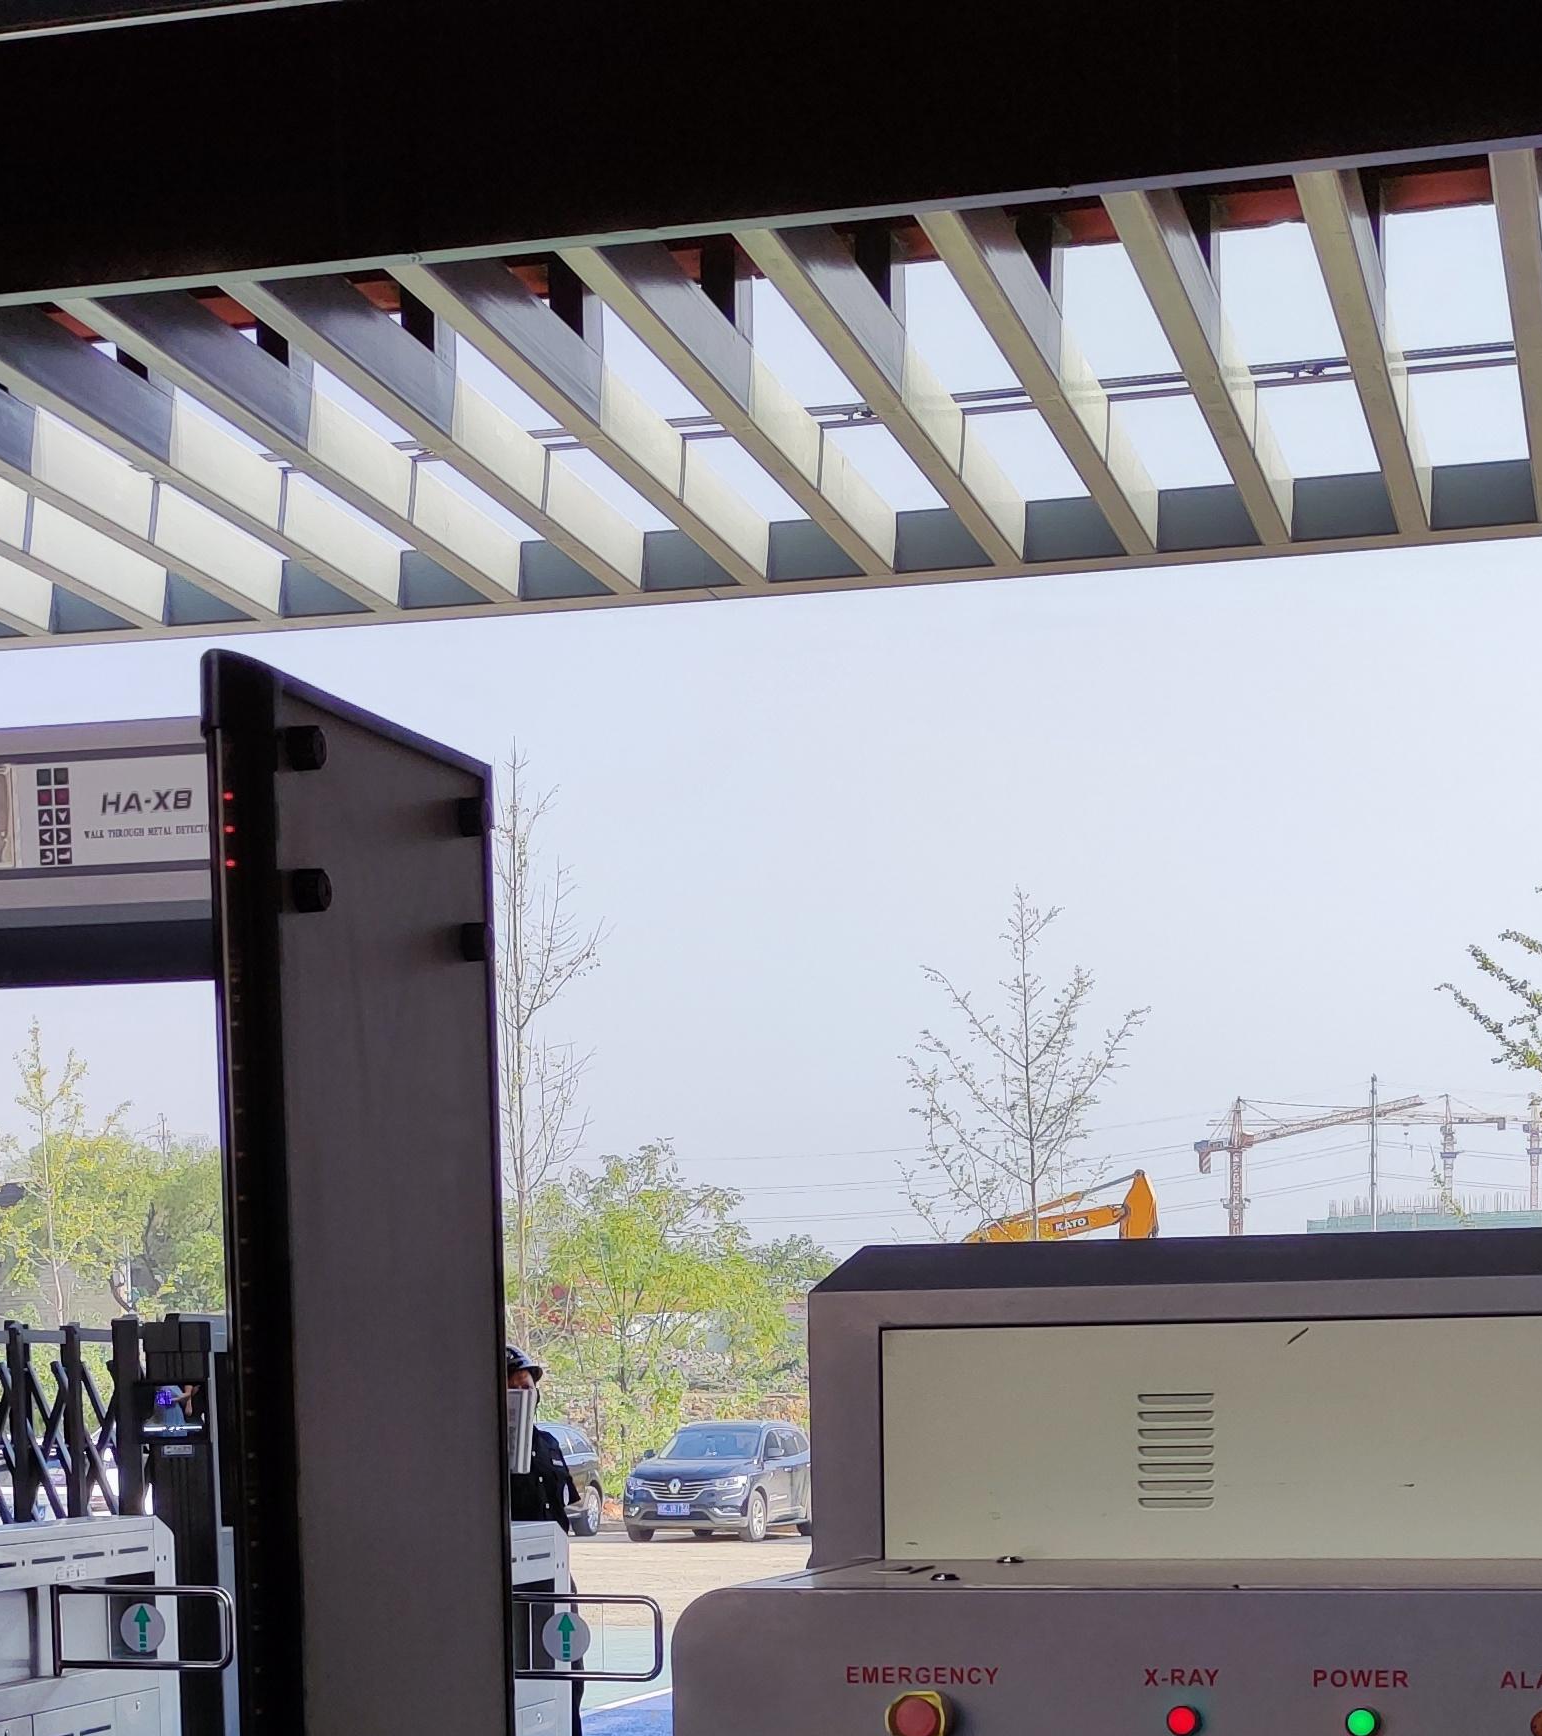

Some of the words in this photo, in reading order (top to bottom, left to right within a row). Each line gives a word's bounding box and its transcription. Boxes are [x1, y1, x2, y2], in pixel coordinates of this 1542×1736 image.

[84, 830, 104, 839] WALK
[148, 826, 171, 836] METAL
[1055, 1217, 1087, 1232] KATO
[846, 1666, 1000, 1685] EMERGENCY
[1144, 1668, 1220, 1687] X-RAY
[1312, 1669, 1409, 1689] POWER
